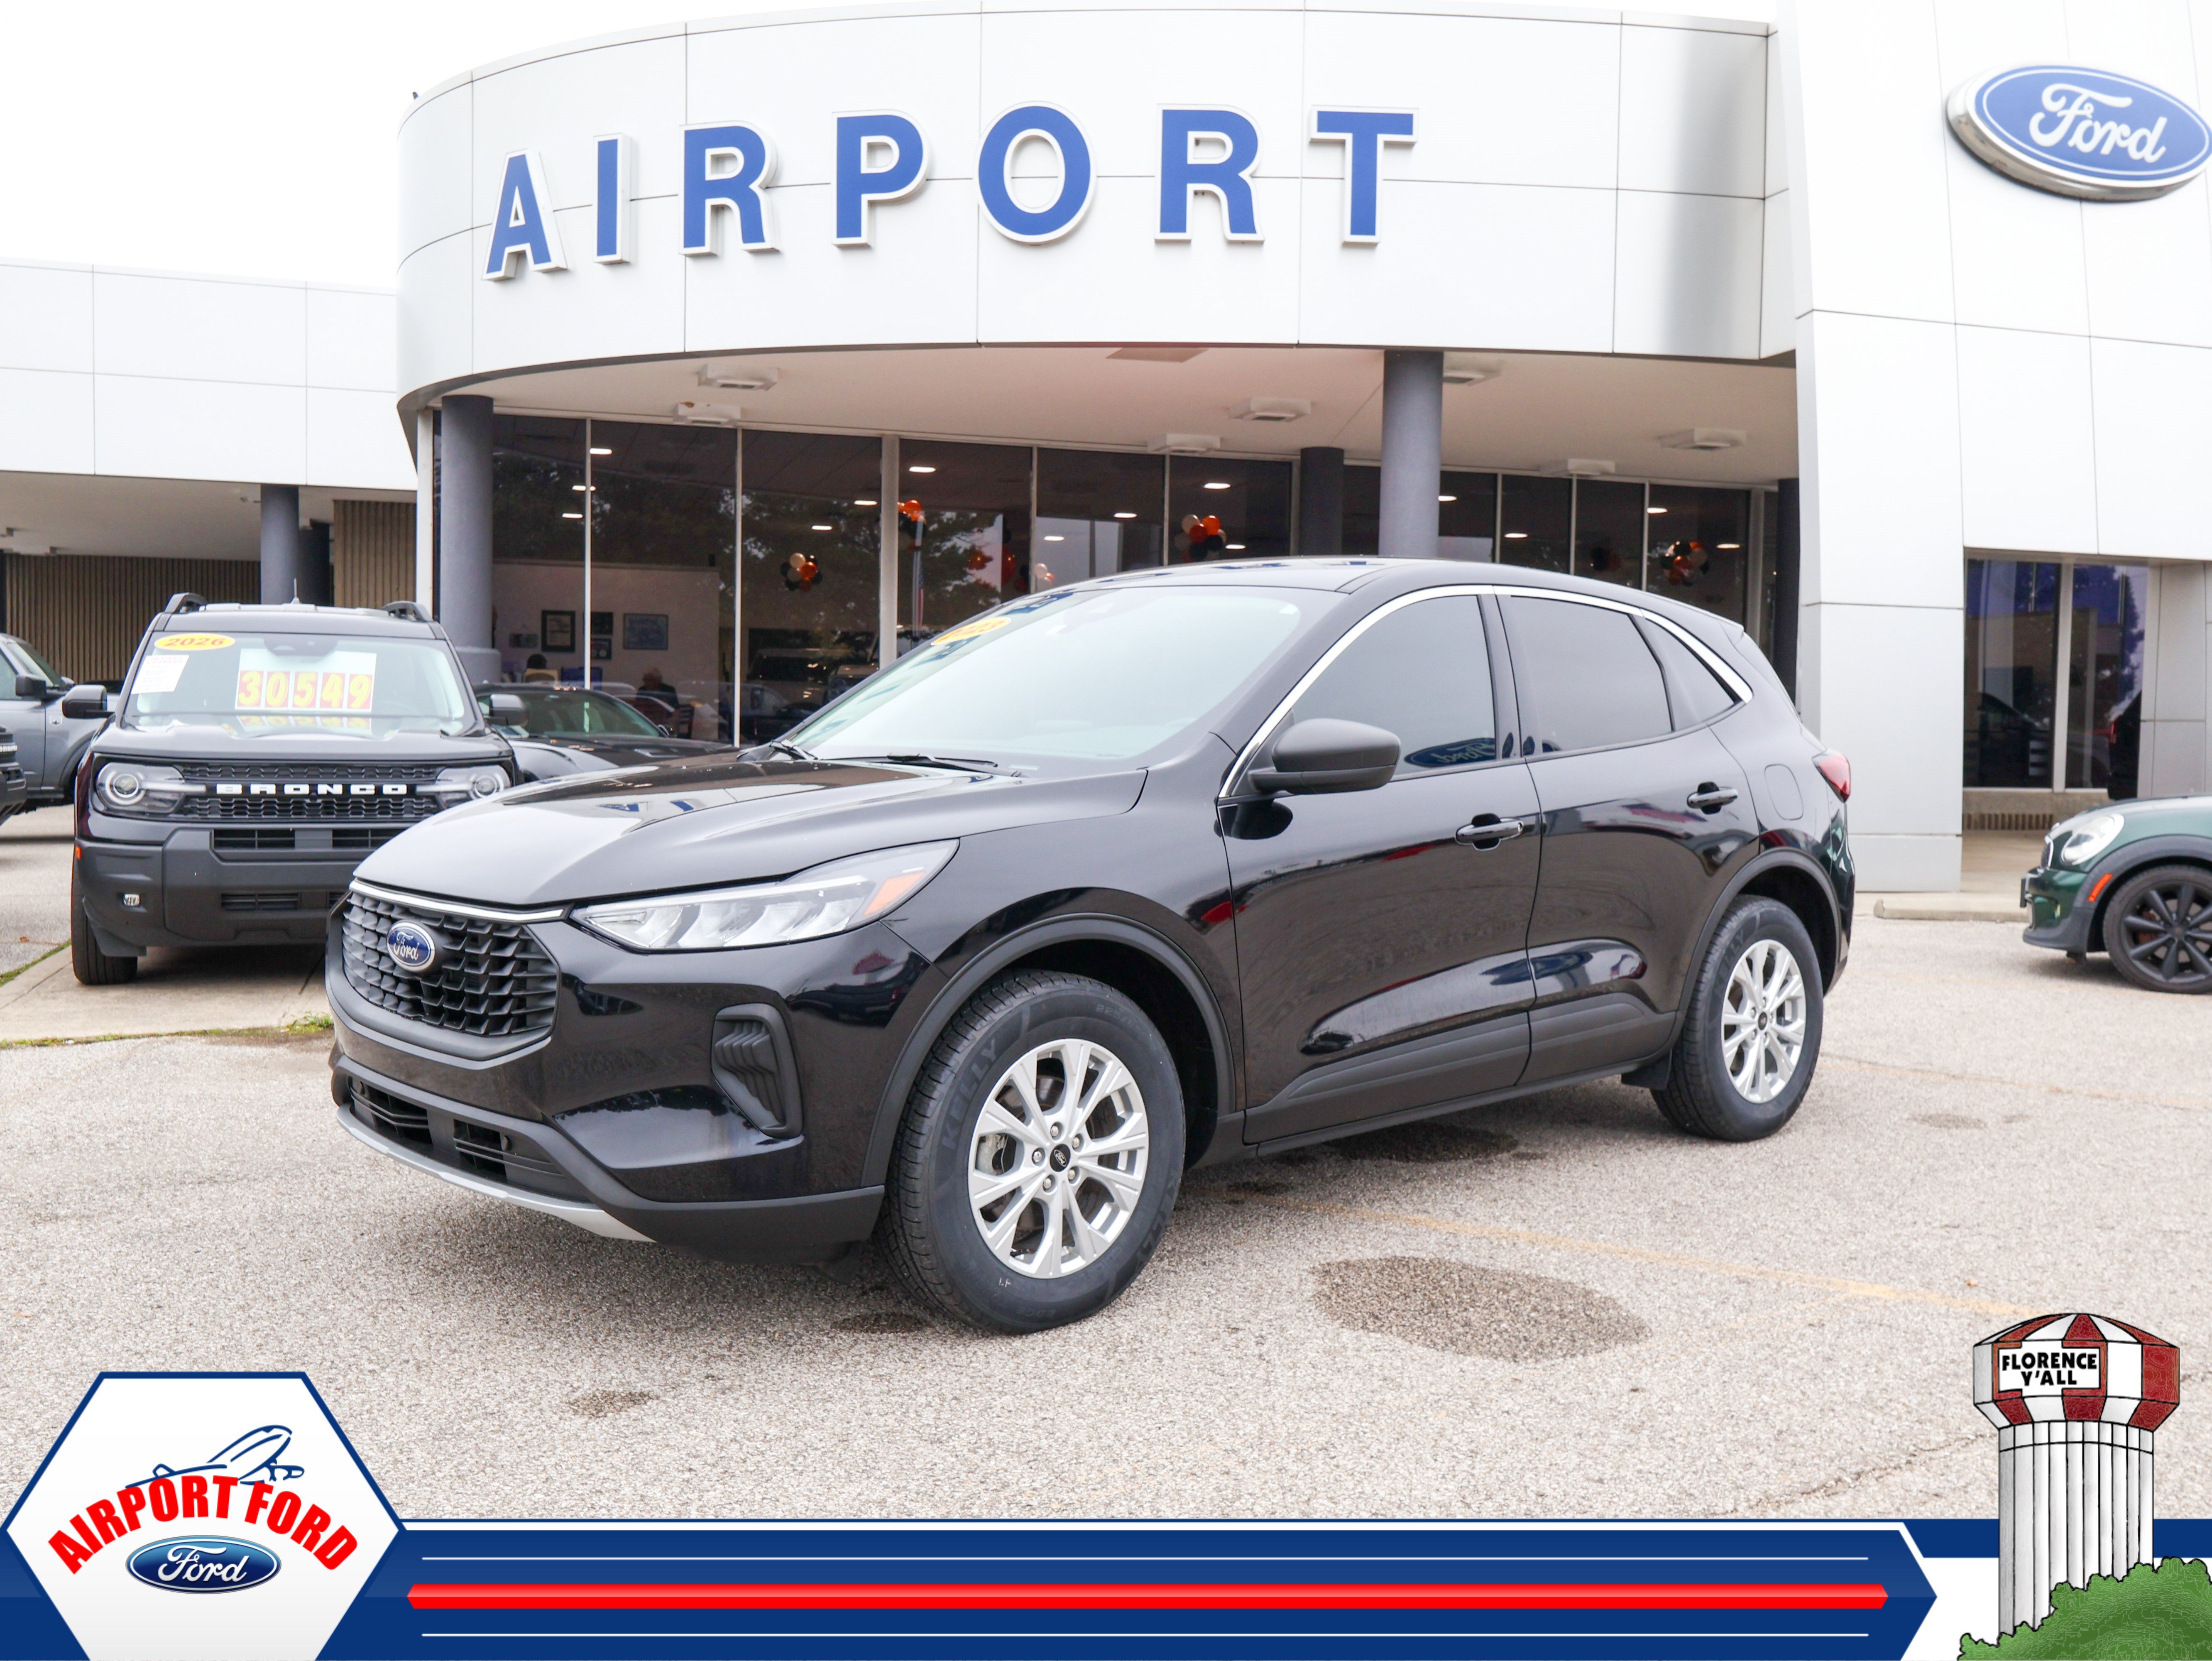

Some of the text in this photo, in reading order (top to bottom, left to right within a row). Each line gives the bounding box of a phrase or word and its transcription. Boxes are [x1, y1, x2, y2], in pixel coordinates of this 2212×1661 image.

[2029, 83, 2168, 163] Ford
[482, 101, 1417, 280] AIRPORT
[164, 637, 226, 647] 2026
[237, 671, 372, 707] 30549
[216, 784, 407, 795] BRONCO
[393, 931, 420, 960] Ford
[942, 1038, 997, 1150] KELLY
